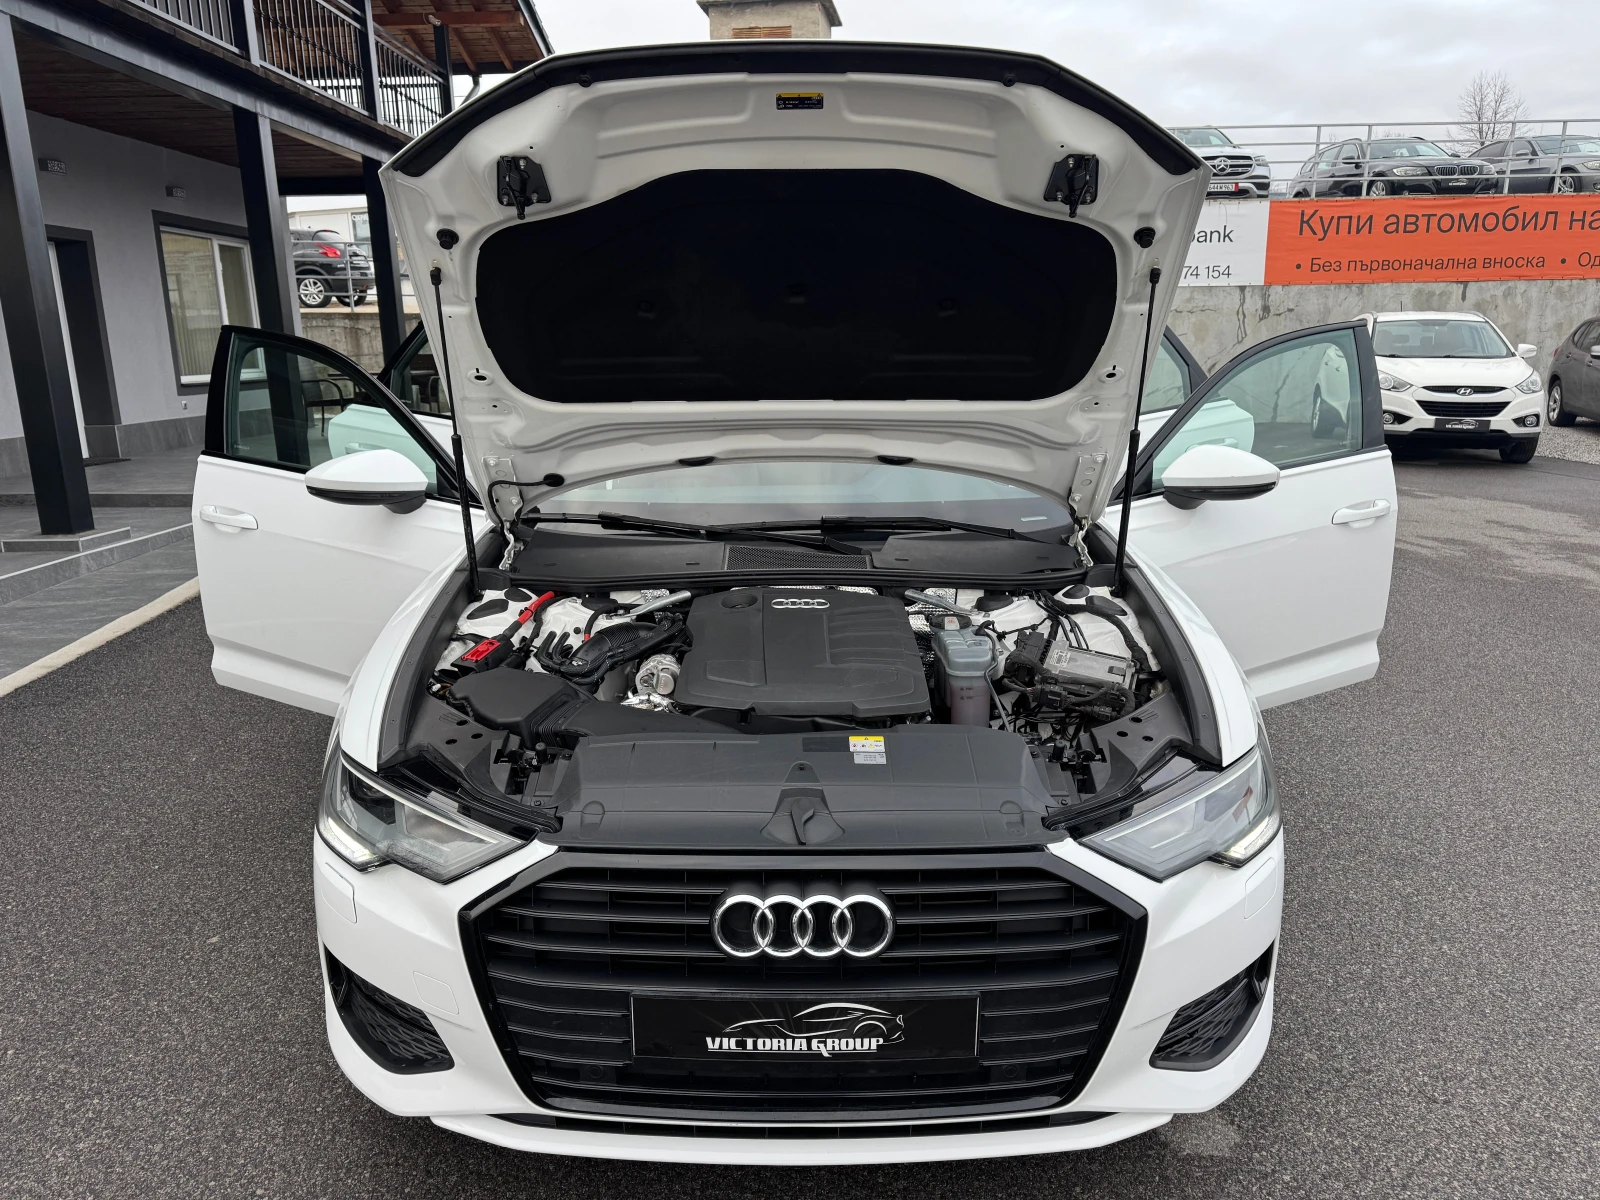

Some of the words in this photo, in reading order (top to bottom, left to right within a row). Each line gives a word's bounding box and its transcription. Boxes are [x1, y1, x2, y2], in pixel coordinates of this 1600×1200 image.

[1191, 224, 1235, 243] ank
[1298, 209, 1374, 242] Купи
[1383, 205, 1559, 234] автомобил
[1568, 209, 1600, 231] на
[1205, 264, 1232, 279] 154
[1309, 257, 1342, 273] Без
[1347, 256, 1477, 274] първоначална
[1482, 254, 1546, 270] вноска
[705, 1036, 808, 1051] VICTORIA
[811, 1037, 884, 1057] GROUP
